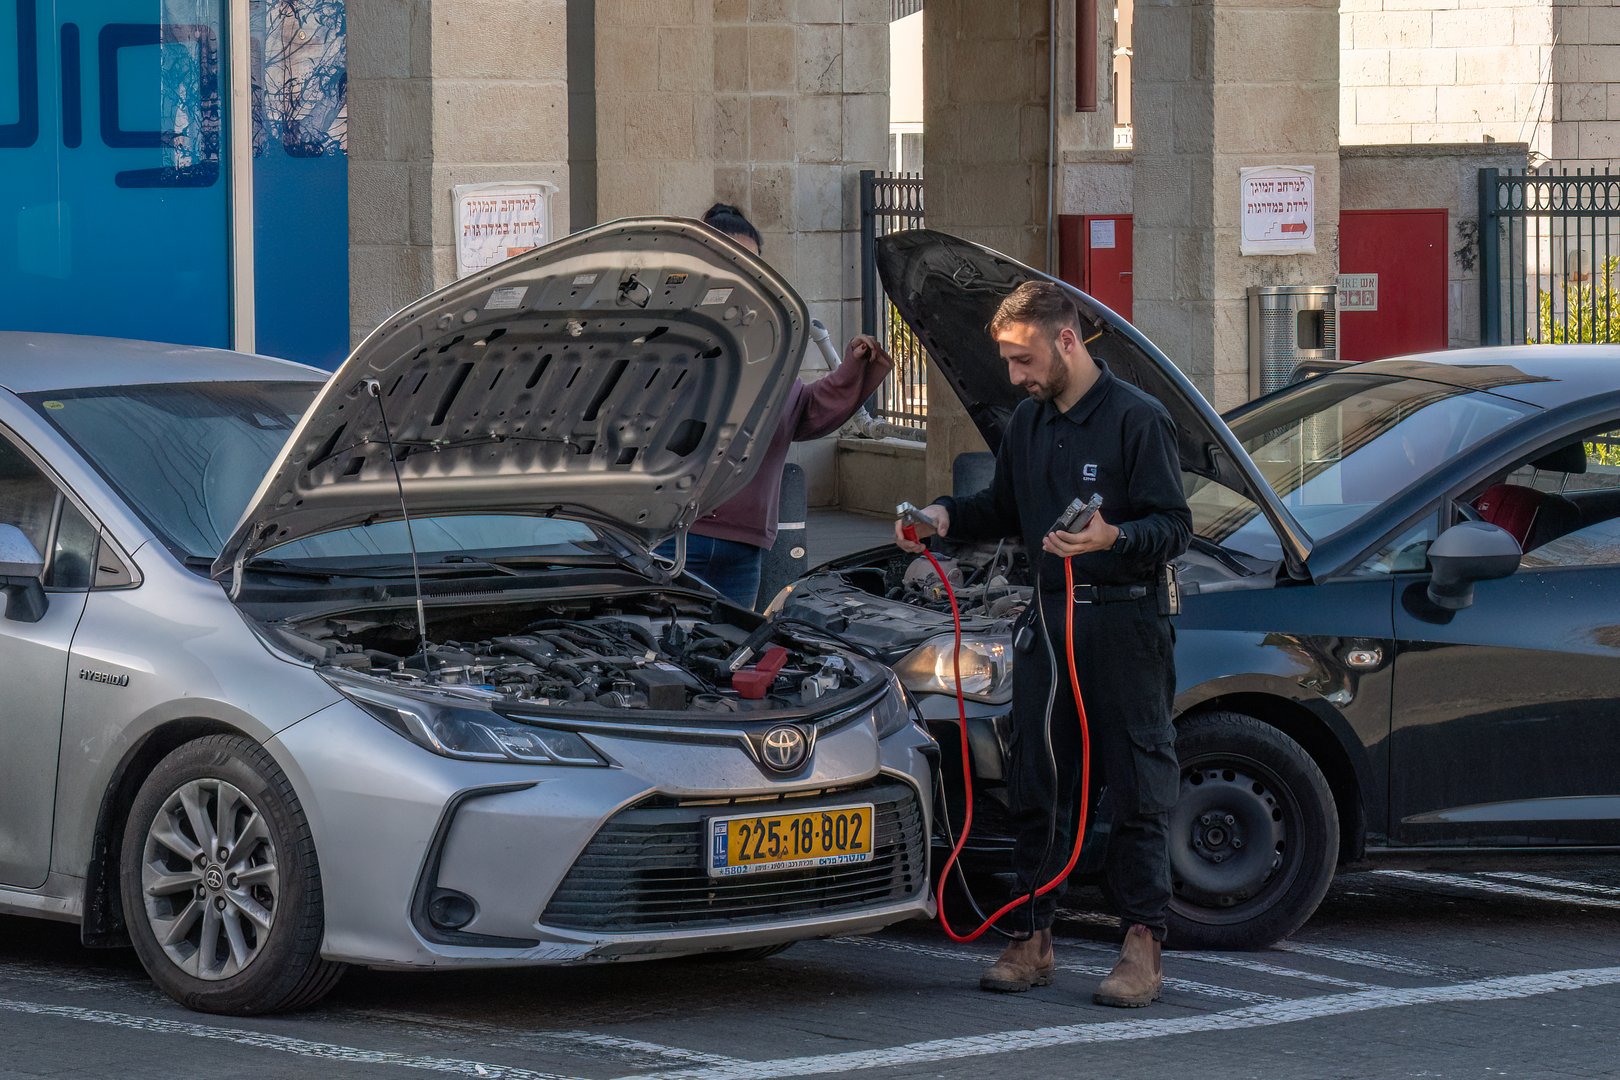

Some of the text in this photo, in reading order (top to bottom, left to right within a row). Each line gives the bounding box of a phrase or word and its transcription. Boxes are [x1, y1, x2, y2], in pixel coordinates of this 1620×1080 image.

[1250, 177, 1305, 196] למרחב המוגן
[467, 195, 536, 216] למרחב המוגן
[1247, 197, 1308, 214] לרדת במדרגות
[463, 217, 540, 236] לרדת במדרגות
[1340, 278, 1359, 288] IRE
[1361, 278, 1375, 288] אש
[79, 669, 120, 685] HYBRID
